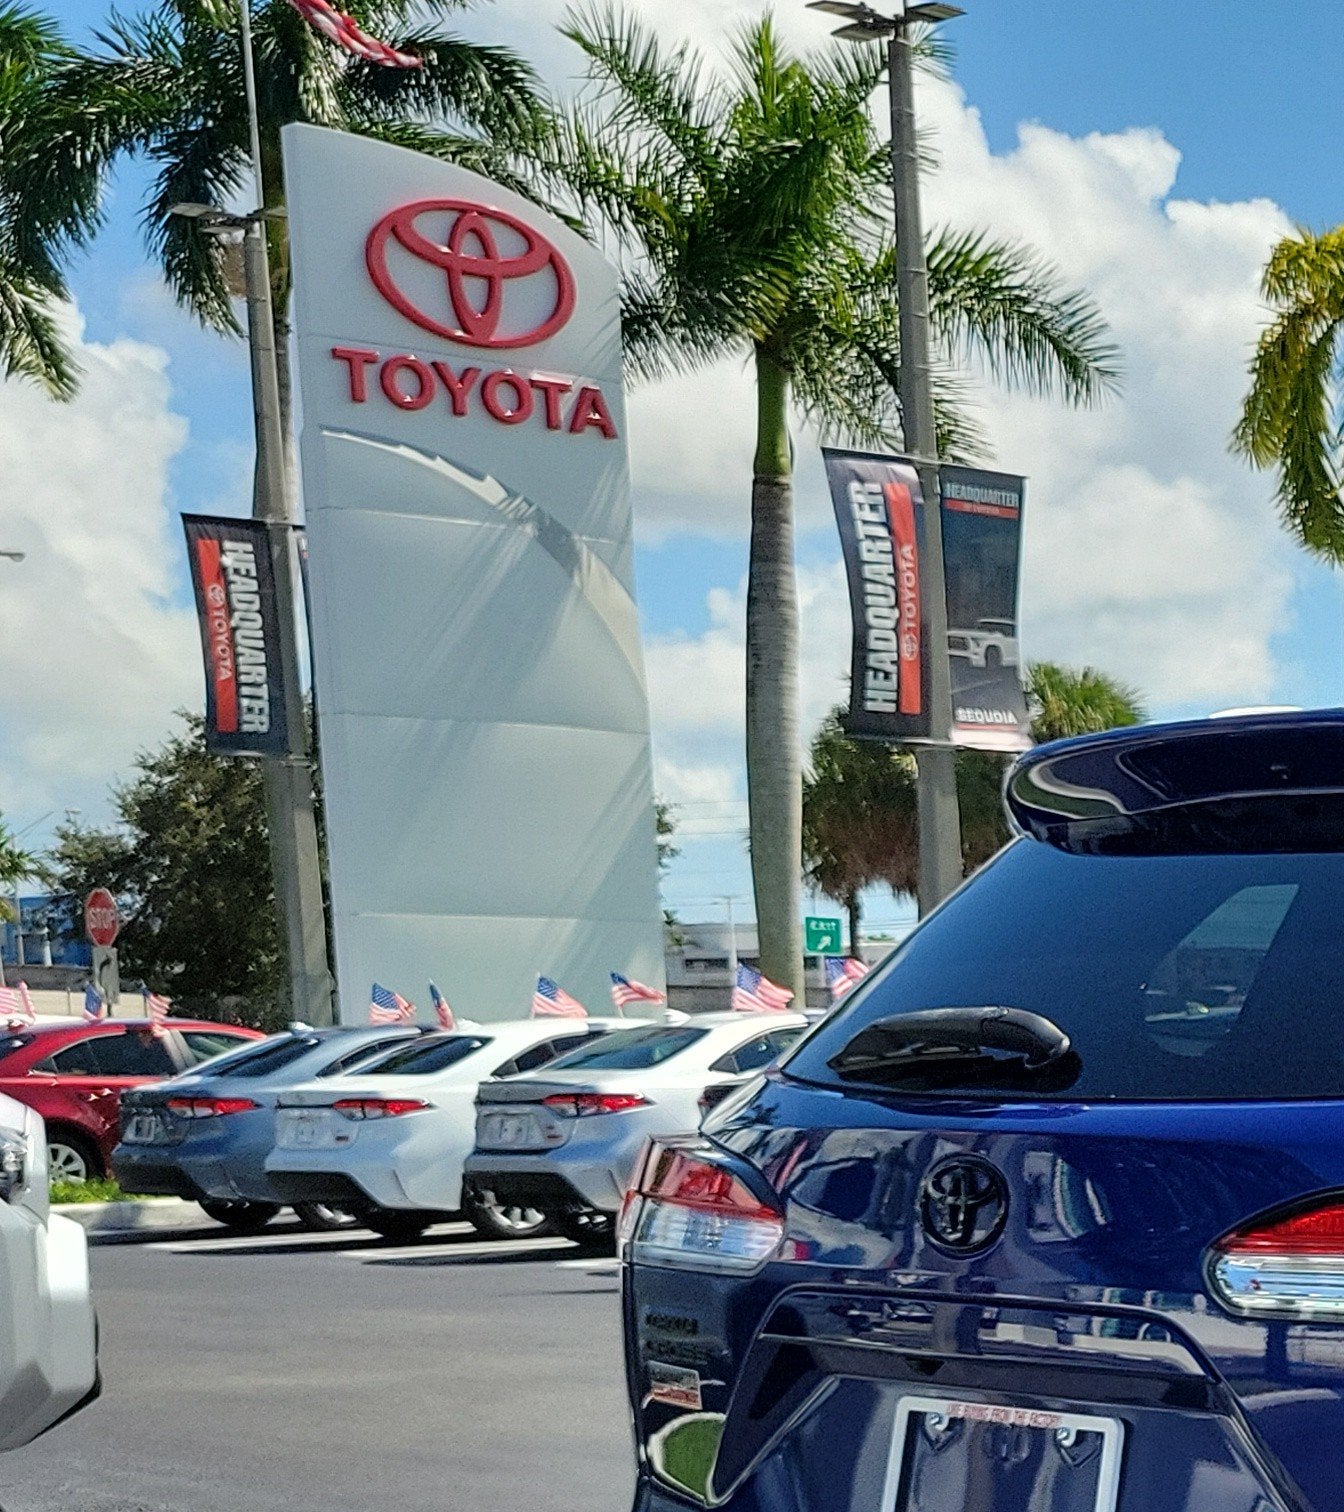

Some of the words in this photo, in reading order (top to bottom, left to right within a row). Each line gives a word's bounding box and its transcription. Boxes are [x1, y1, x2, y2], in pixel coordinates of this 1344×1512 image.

[331, 346, 619, 440] TOYOTA
[850, 480, 899, 714] HEADQUARTER
[900, 544, 919, 631] TOYOTA
[210, 608, 233, 681] TOYOTA
[221, 539, 270, 733] HEADQUARTER
[955, 707, 1019, 725] SEQUOIA
[88, 906, 116, 930] STOP
